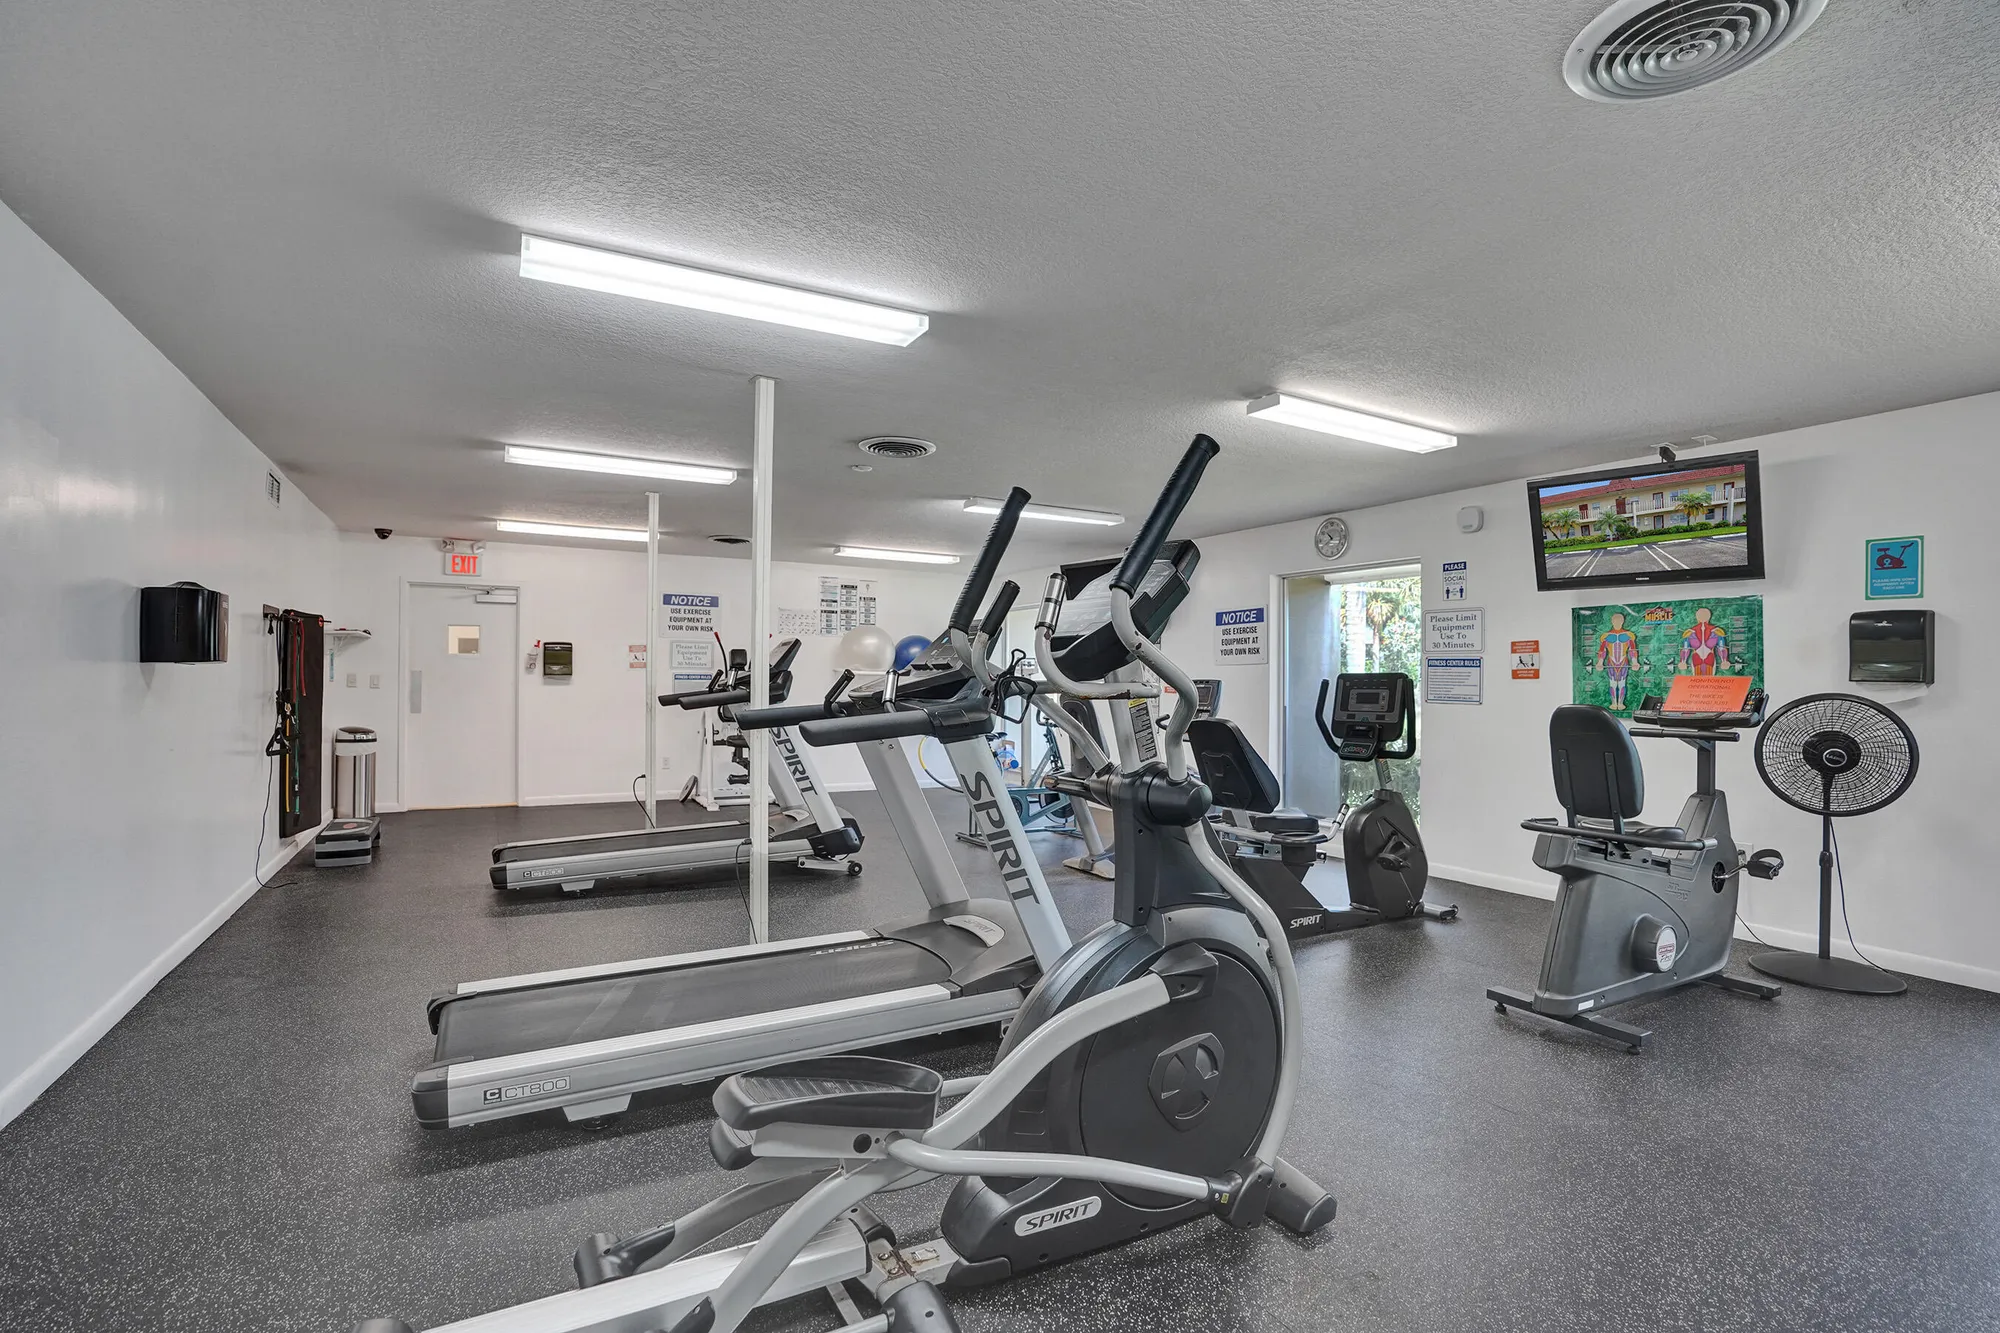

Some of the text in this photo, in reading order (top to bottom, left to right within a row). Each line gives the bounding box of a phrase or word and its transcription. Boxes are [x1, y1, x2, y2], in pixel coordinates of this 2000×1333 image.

[451, 554, 478, 574] EXIT
[1444, 562, 1465, 571] PLEASE
[670, 595, 711, 606] NOTICE
[683, 608, 711, 616] EXERCISE
[669, 616, 703, 624] EQUIPMENT
[1222, 611, 1257, 624] NOTICE
[1430, 615, 1454, 623] Please
[1222, 626, 1257, 636] USE EXERCISE
[1432, 623, 1475, 633] Equipment
[1221, 636, 1259, 646] EQUIPMENT AT
[1443, 641, 1475, 649] Minutes
[1220, 648, 1233, 656] YOUR
[1248, 647, 1260, 655] RISK
[770, 727, 818, 796] SPIRIT
[960, 771, 1040, 904] SPIRIT
[1290, 914, 1322, 929] SPIRIT
[505, 1078, 567, 1099] CT800
[1023, 1200, 1094, 1233] SPIRIT
